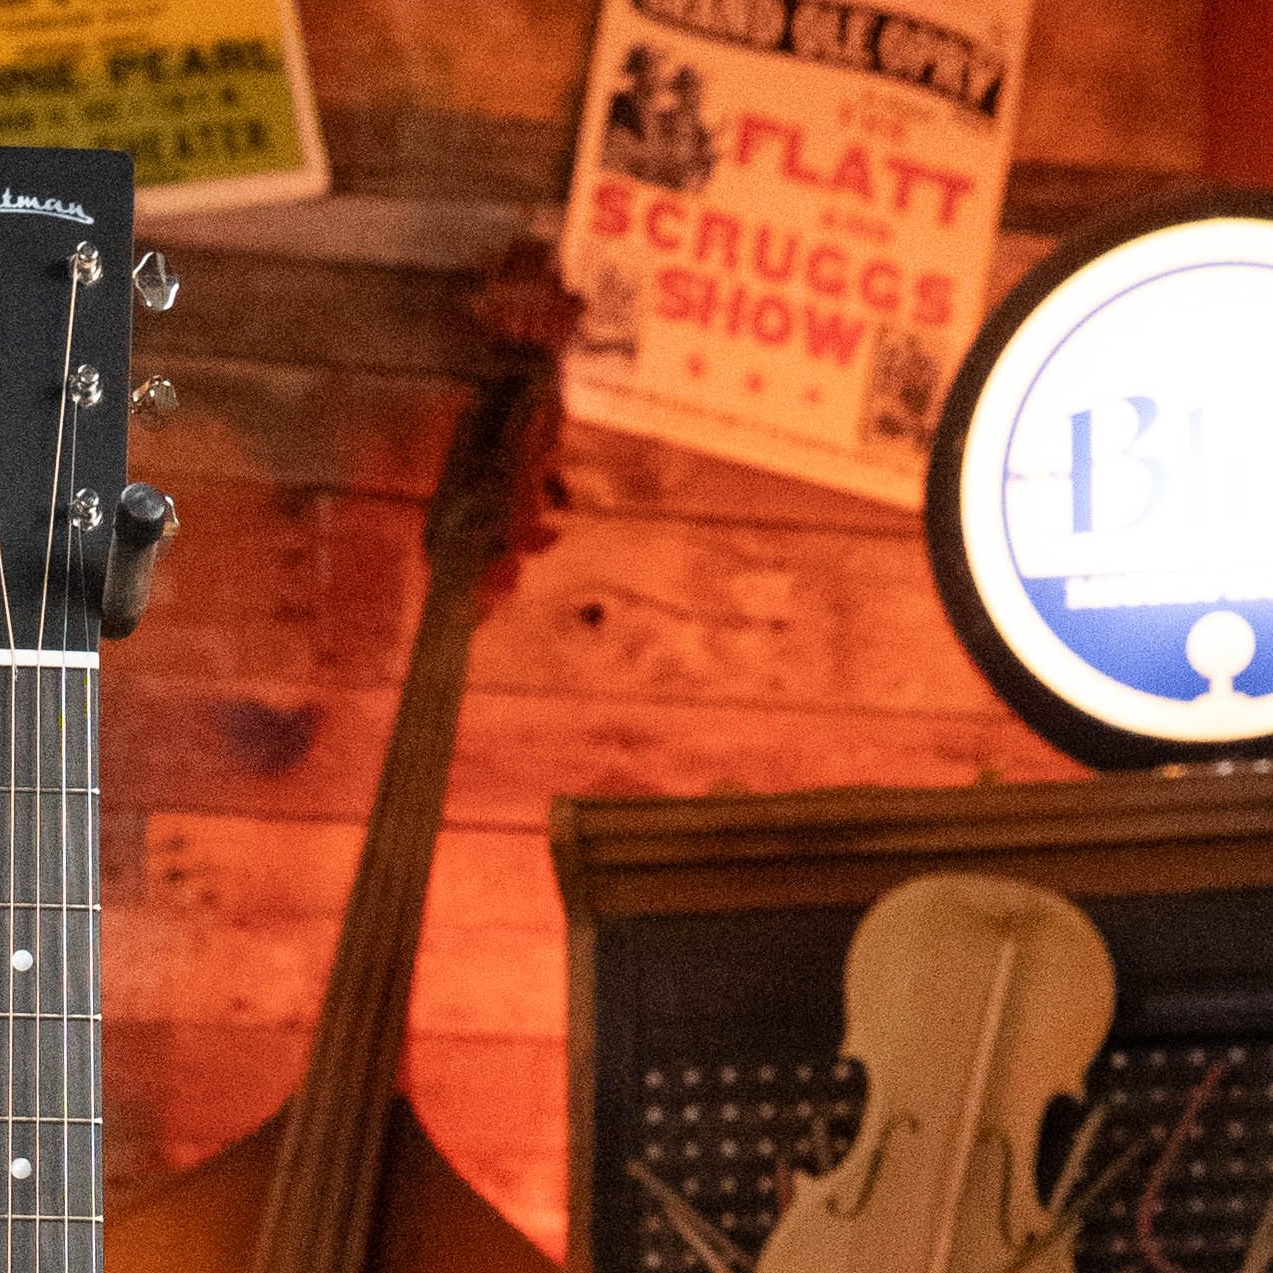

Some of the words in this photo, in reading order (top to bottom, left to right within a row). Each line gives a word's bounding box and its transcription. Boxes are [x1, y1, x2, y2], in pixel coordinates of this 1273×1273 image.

[735, 111, 978, 228] FLATT
[590, 179, 955, 328] SCRUGGS
[654, 266, 867, 366] SHOW
